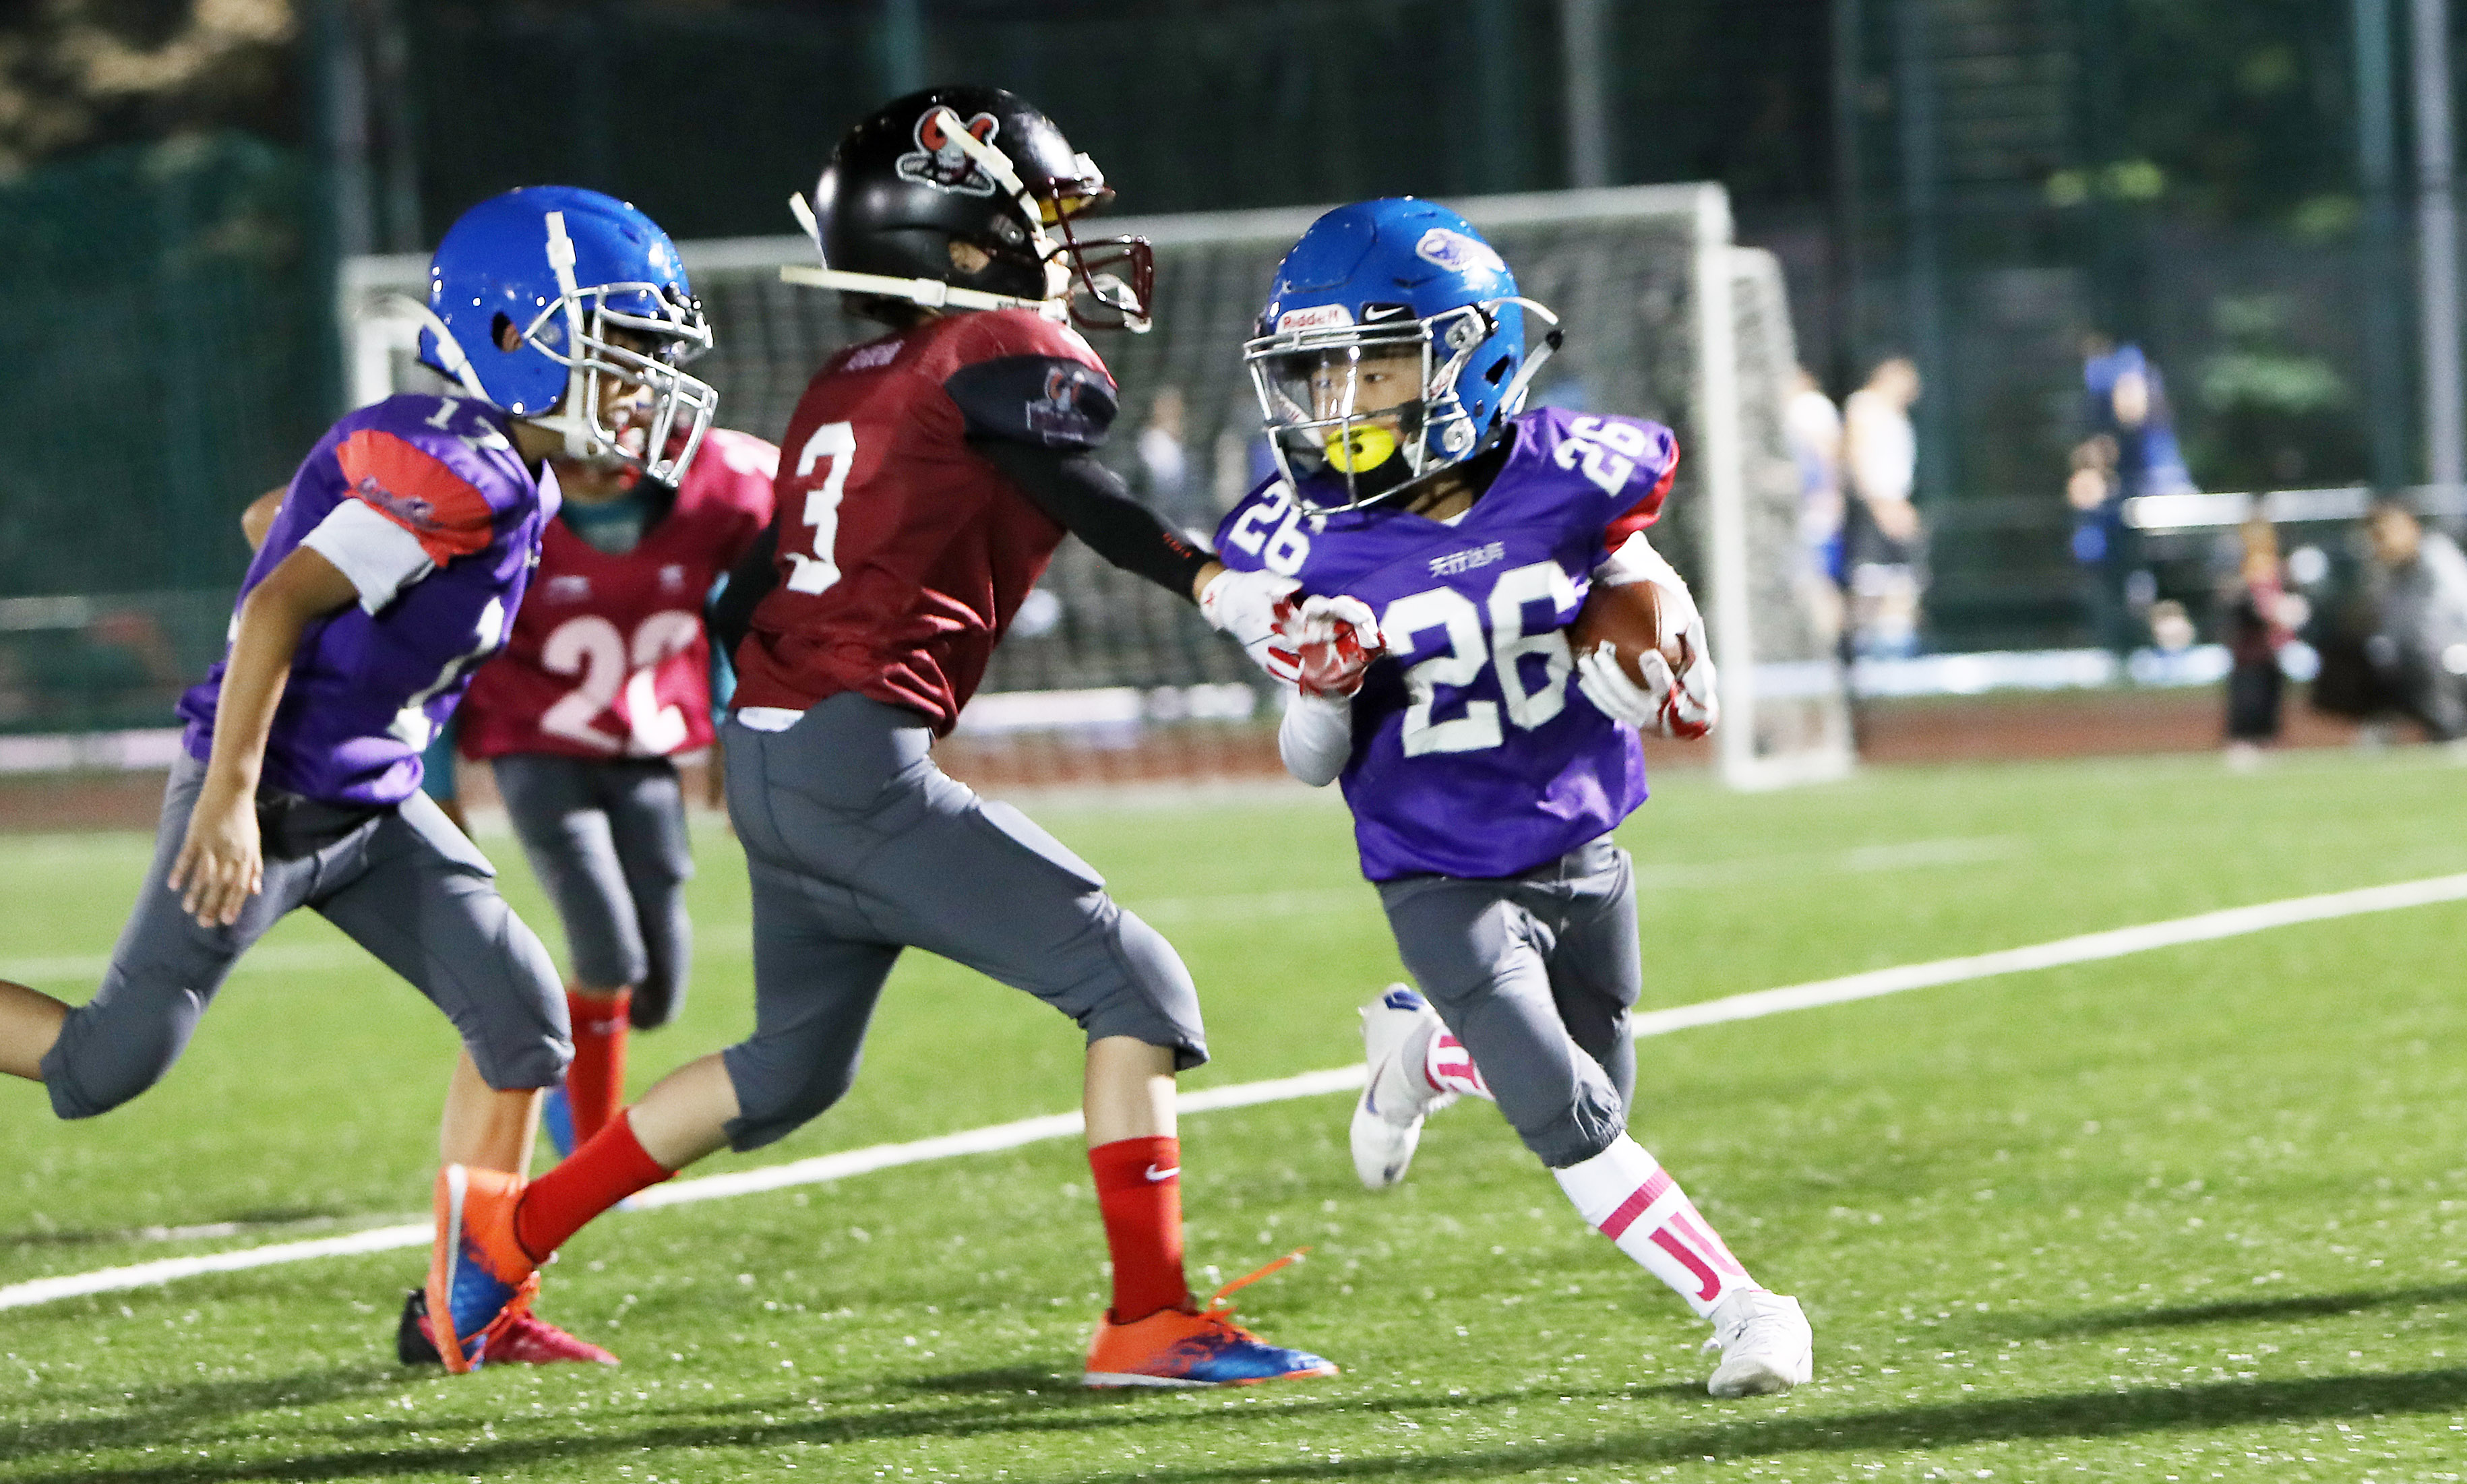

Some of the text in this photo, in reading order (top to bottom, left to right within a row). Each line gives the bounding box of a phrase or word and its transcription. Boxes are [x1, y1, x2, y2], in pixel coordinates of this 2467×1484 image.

[784, 421, 857, 596] 3
[1554, 416, 1645, 499] 26
[1228, 479, 1327, 577] 26
[1379, 559, 1577, 758] 26
